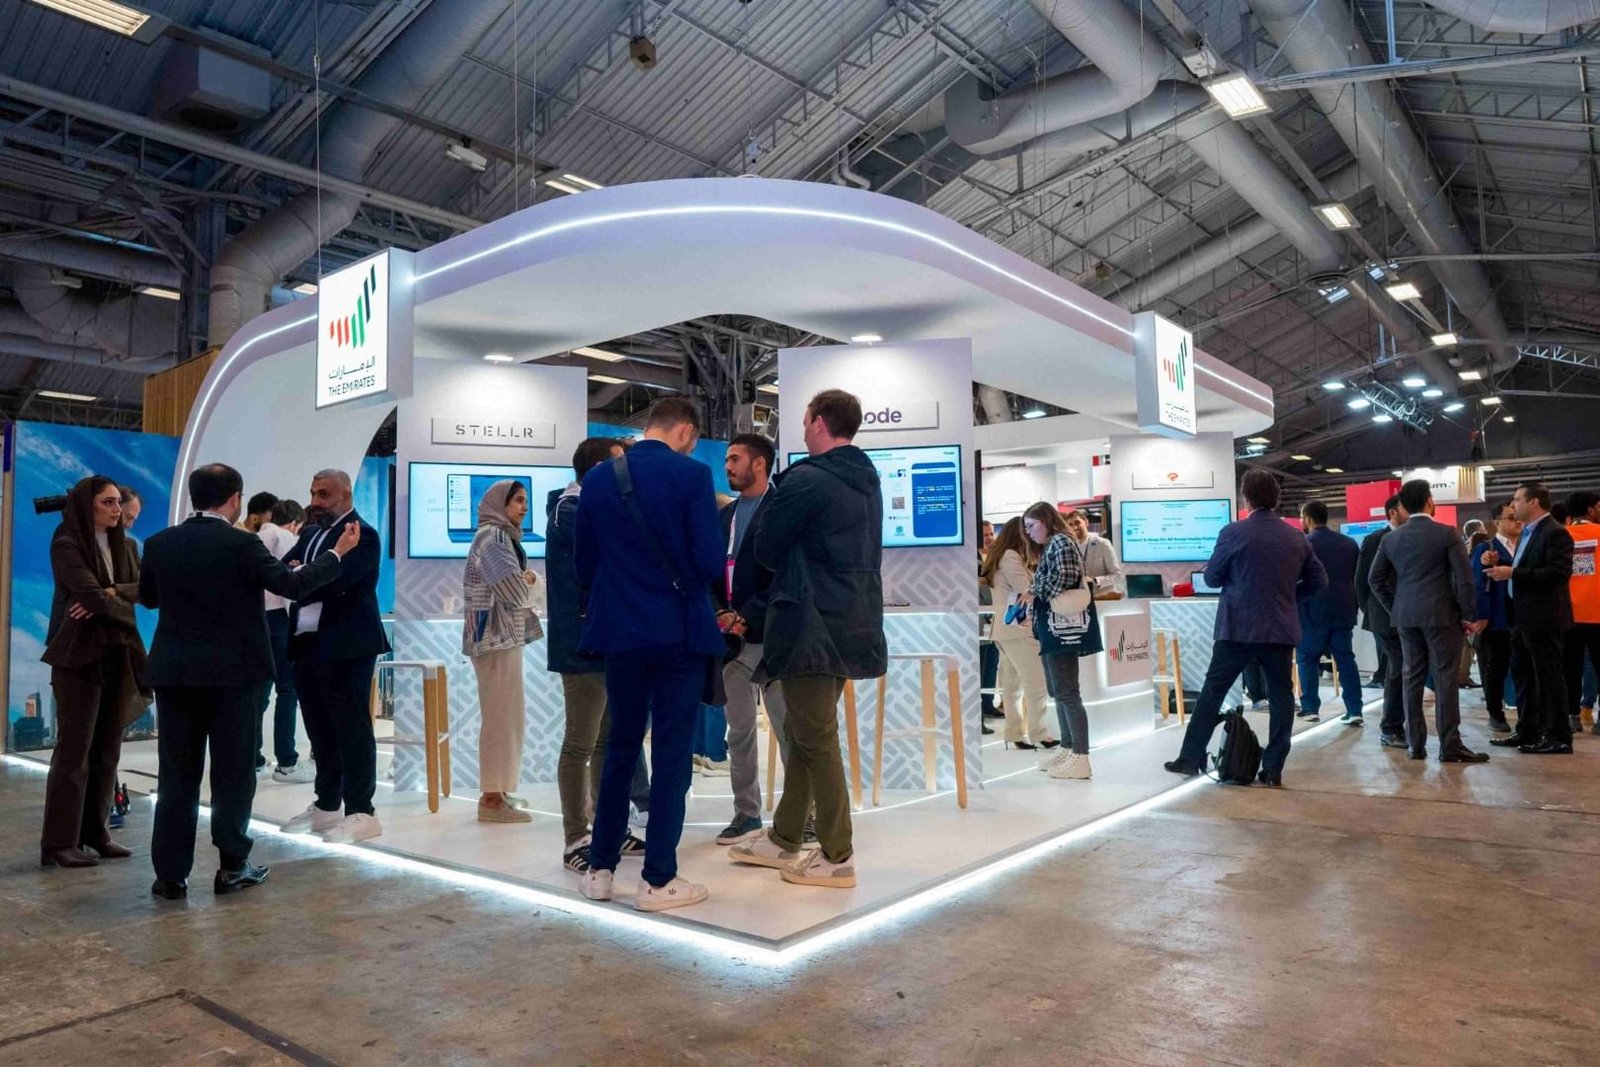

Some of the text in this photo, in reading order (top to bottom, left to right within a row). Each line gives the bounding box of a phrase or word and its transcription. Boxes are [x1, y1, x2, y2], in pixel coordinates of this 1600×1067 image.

[328, 375, 376, 397] THE EMIRATES
[863, 407, 903, 424] ode
[455, 424, 534, 438] STELLR
